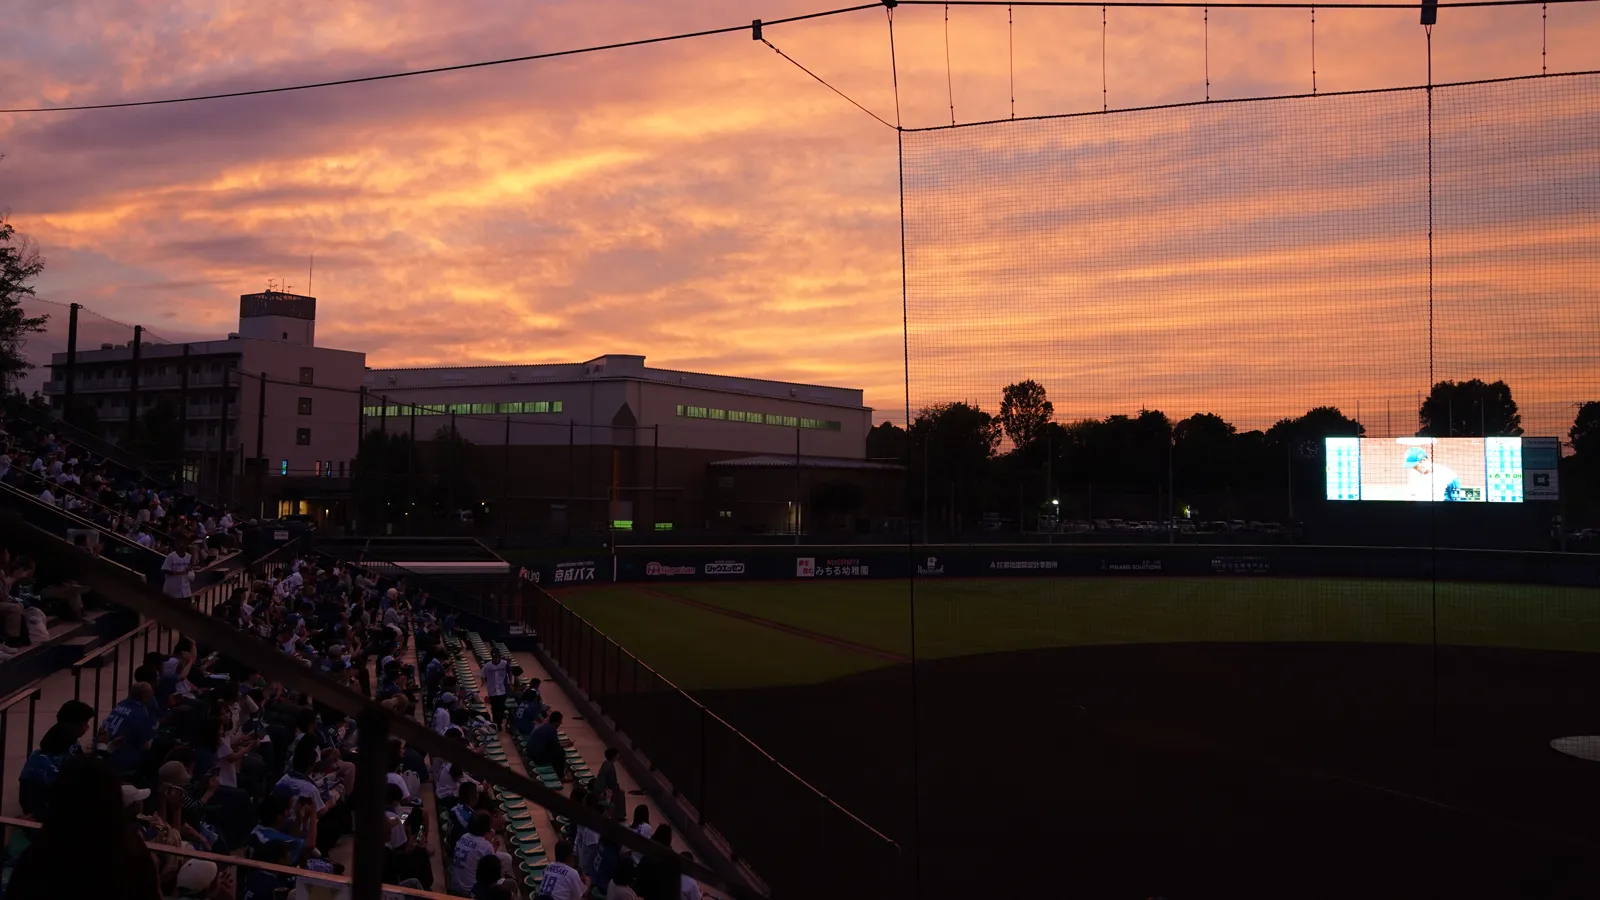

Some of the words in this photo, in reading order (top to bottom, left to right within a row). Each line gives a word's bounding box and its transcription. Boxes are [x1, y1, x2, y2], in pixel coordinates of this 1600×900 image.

[554, 567, 596, 582] 京成バス
[816, 565, 869, 576] みちる幼稚園
